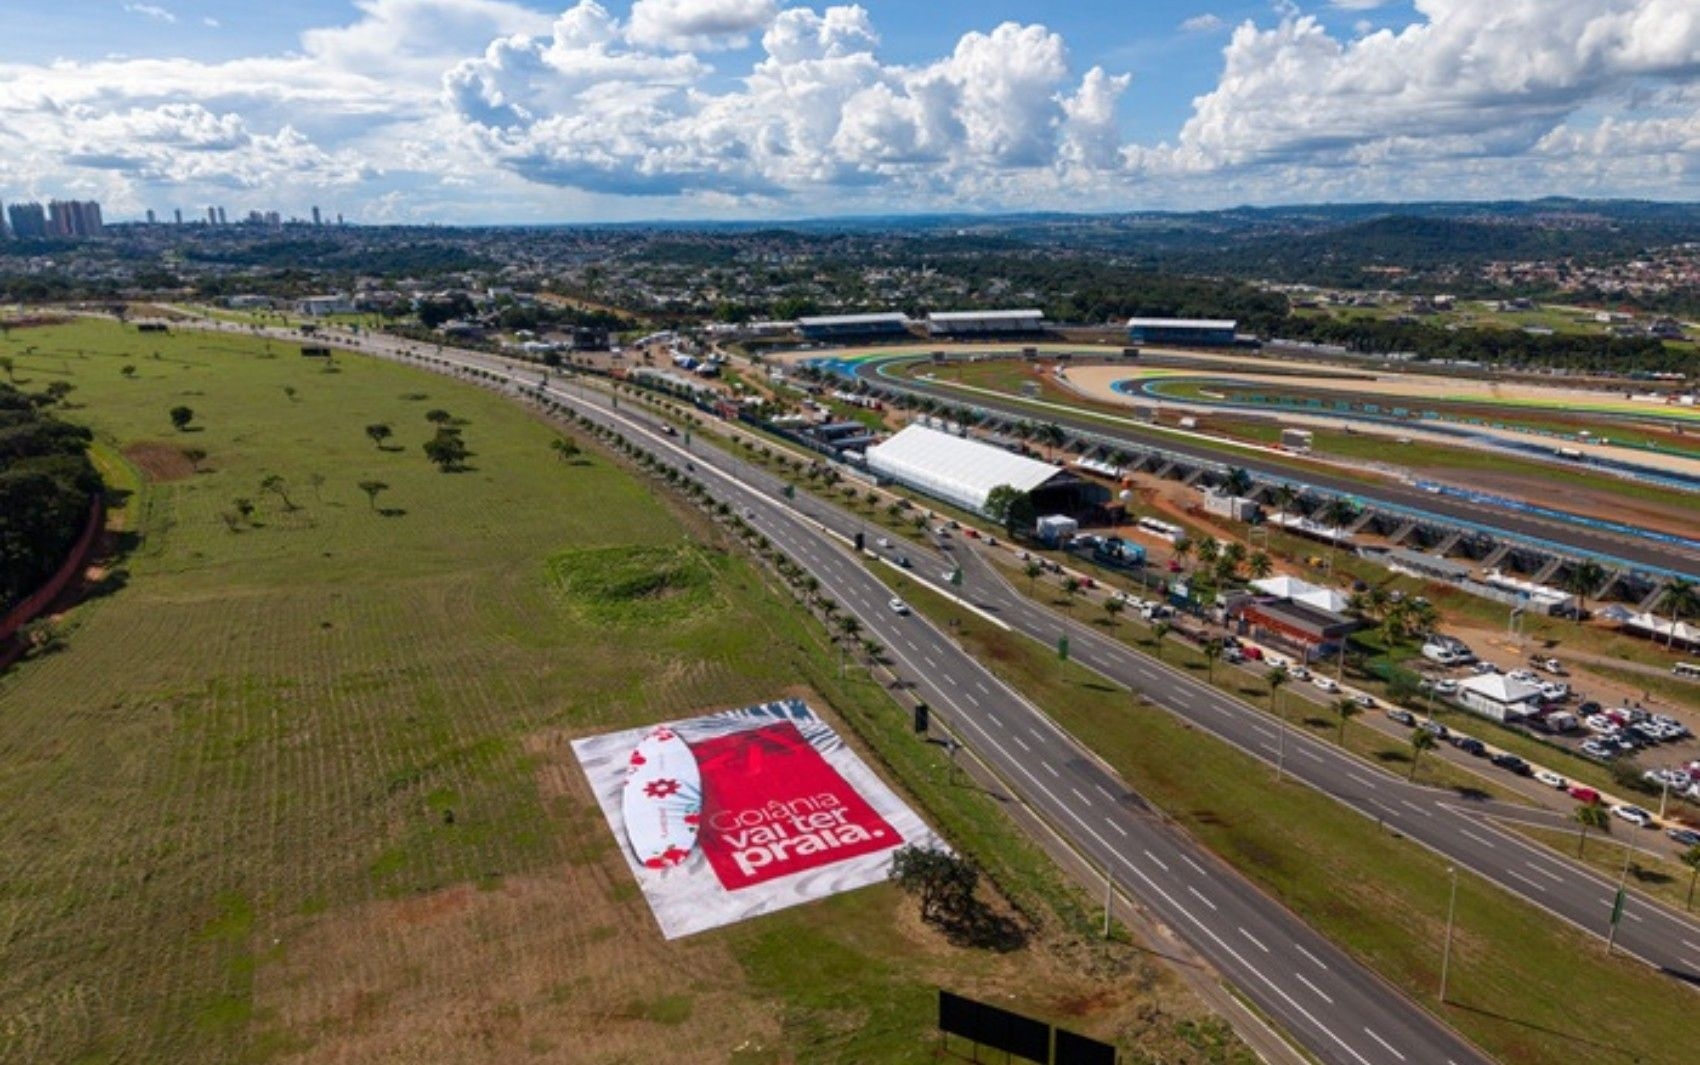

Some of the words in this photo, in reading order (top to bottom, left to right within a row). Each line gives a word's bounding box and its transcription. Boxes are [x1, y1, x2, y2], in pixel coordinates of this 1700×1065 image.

[722, 822, 788, 849] vai
[788, 807, 849, 833] ter
[731, 824, 885, 876] praia.
